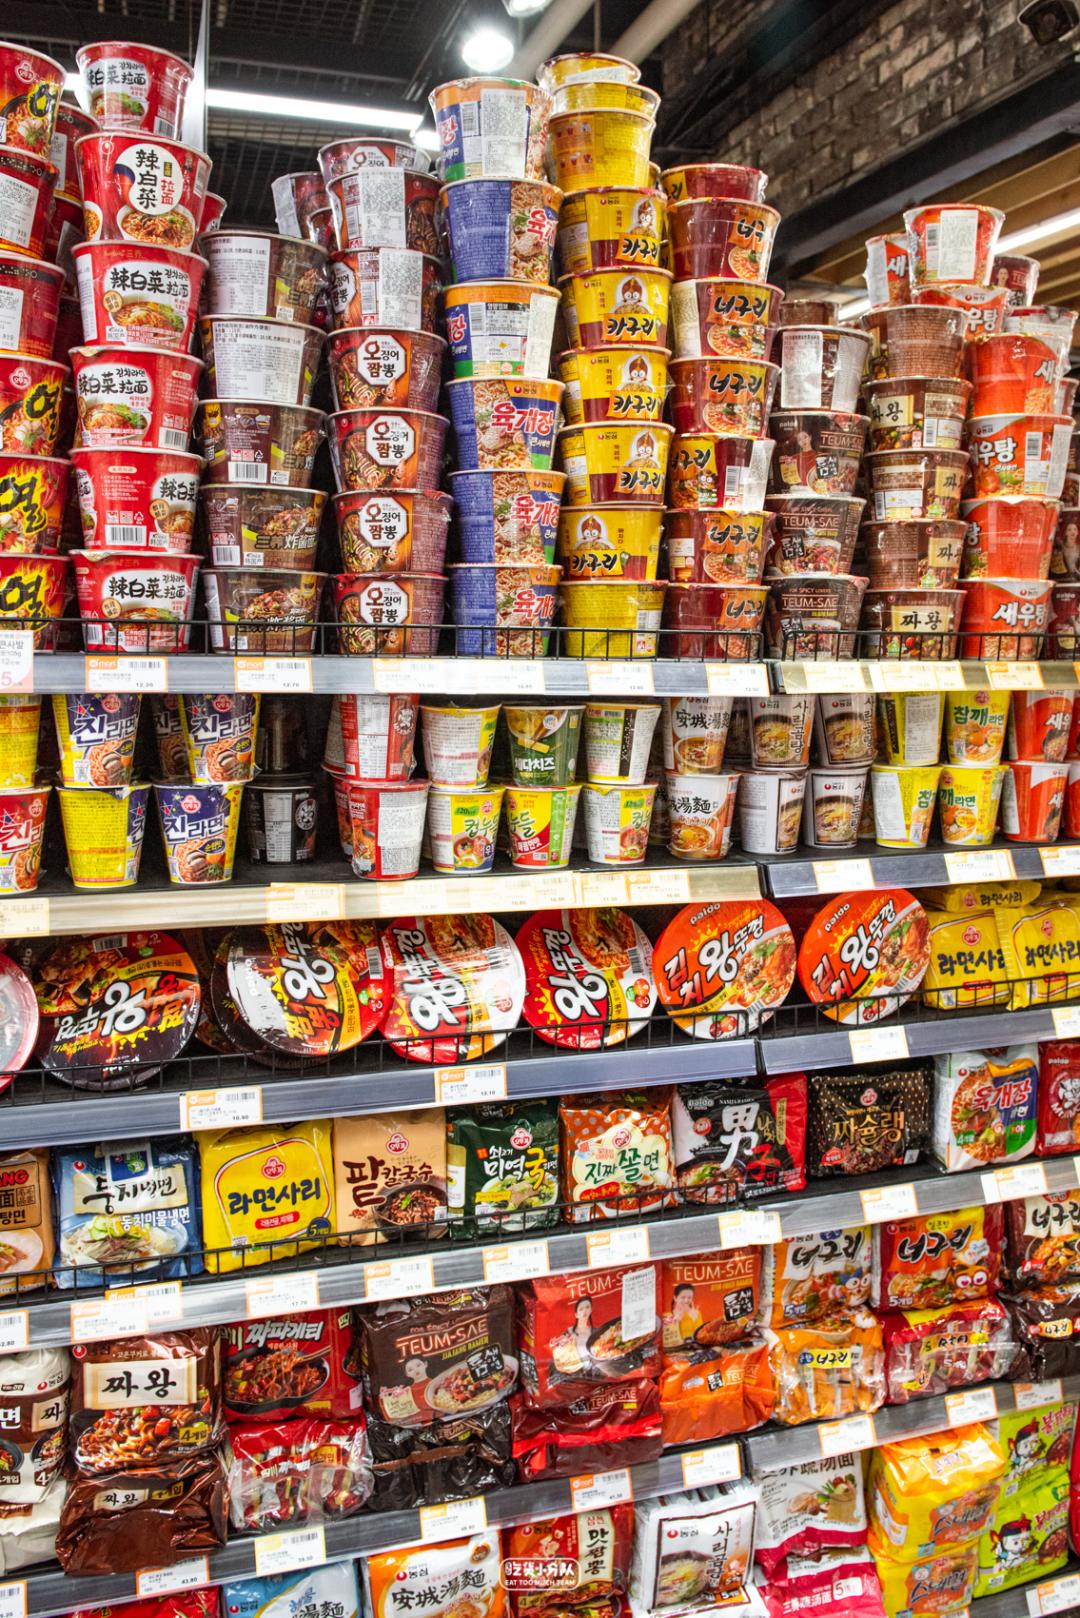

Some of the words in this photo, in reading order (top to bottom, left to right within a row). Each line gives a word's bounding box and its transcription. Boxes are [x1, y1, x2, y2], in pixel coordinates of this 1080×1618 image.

[136, 149, 160, 209] 辣白菜
[160, 179, 176, 205] 拉面
[622, 238, 659, 258] 카구리
[110, 267, 165, 293] 辣白菜
[715, 295, 768, 317] 너구리
[607, 316, 654, 337] 카구리
[363, 341, 400, 361] 오징어
[367, 361, 396, 378] 짬뽕
[119, 380, 148, 395] 拉面
[709, 373, 762, 395] 너구리
[613, 394, 657, 414] 카구리
[491, 403, 553, 436] 육개장
[372, 422, 409, 442] 오징어
[375, 442, 406, 459] 짬뽕
[621, 472, 664, 489] 카구리
[364, 504, 401, 523] 오징어
[782, 515, 840, 528] TEUM-SAE
[369, 523, 398, 540] 짬뽕
[710, 524, 761, 544] 너구리
[573, 554, 618, 572] 카구리
[108, 577, 163, 598] 辣白菜
[163, 585, 186, 598] 拉面
[366, 588, 402, 607] 오징어
[781, 597, 839, 609] TEUM-SAE
[370, 607, 398, 624] 짬뽕
[954, 706, 1005, 726] 참깨라면
[73, 715, 137, 745] 진라면
[191, 714, 253, 746] 진라면
[165, 816, 226, 844] 진라면
[980, 891, 1023, 905] 라면사리
[690, 903, 721, 925] paldo
[824, 902, 851, 932] paldo
[840, 899, 895, 976] 왕뚜껑
[699, 914, 765, 983] 왕뚜껑
[664, 947, 704, 1007] 김치
[812, 954, 852, 999] 김치
[976, 1078, 1032, 1111] 육개장
[833, 1110, 904, 1145] 짜슐랭
[228, 1178, 321, 1215] 라면사리
[120, 1206, 190, 1231] 동치미물냉면
[792, 1232, 864, 1267] 너구리
[898, 1225, 972, 1263] 너구리
[675, 1261, 753, 1281] TEUM-SAE
[246, 1322, 323, 1347] 짜파게티
[400, 1319, 488, 1357] TEUM-SAE
[816, 1352, 848, 1366] 너구리
[408, 1569, 429, 1581] 농심
[392, 1568, 486, 1612] 安城湯麵
